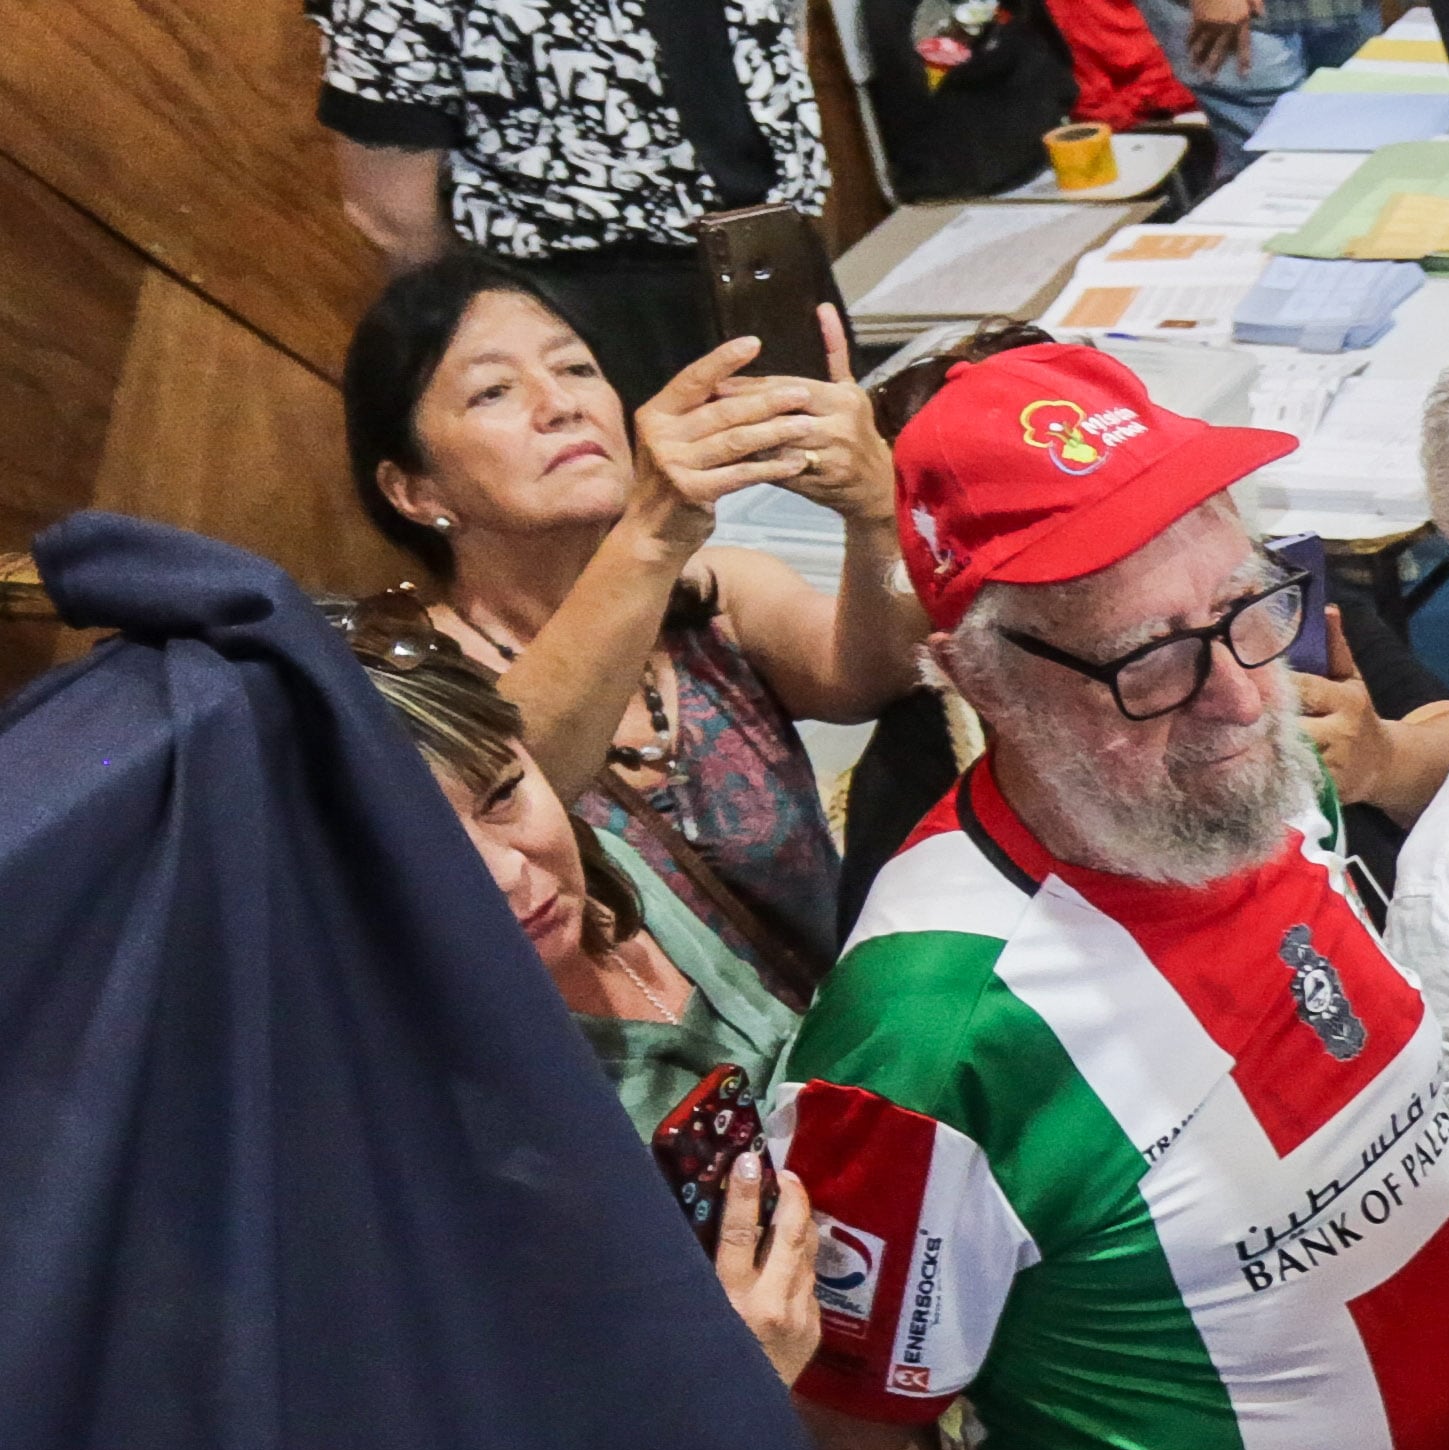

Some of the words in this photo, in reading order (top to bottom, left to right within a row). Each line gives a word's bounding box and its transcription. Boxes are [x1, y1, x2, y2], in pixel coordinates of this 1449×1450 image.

[1242, 1212, 1363, 1292] BANK
[1360, 1172, 1403, 1224] OF
[904, 1237, 943, 1364] ENERSOCKS
